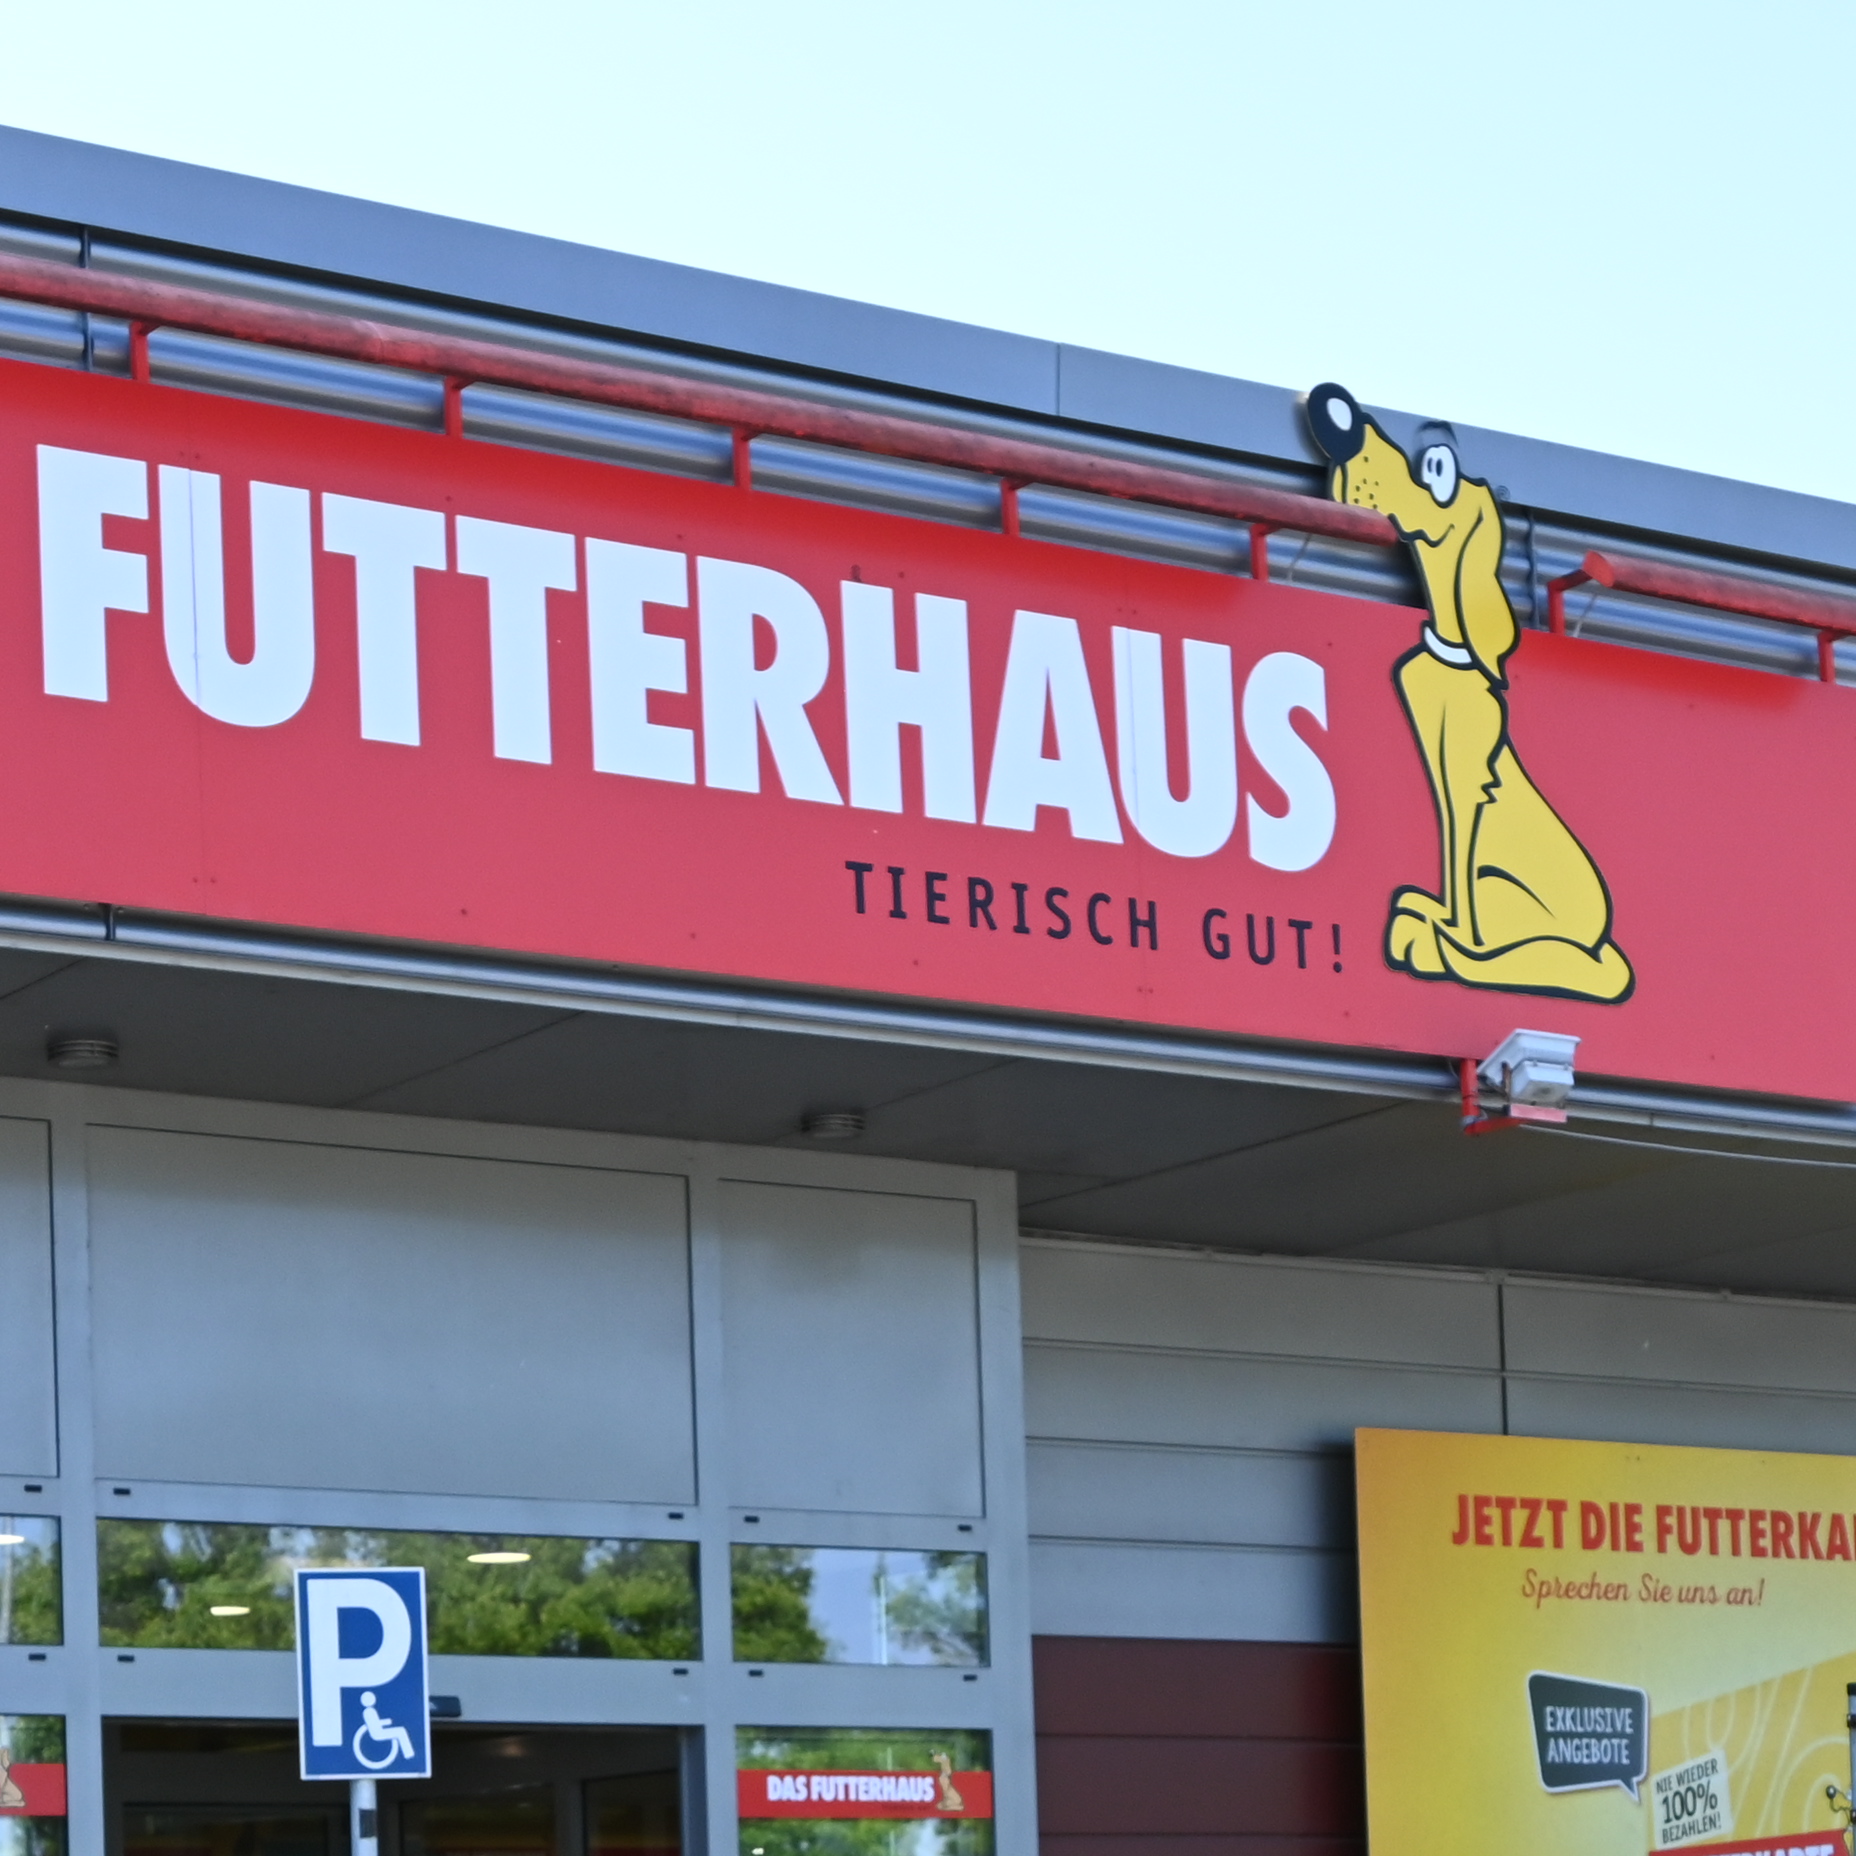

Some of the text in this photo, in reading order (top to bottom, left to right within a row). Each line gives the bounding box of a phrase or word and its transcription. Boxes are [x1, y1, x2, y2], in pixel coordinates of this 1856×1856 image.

[36, 443, 1337, 872] FUTTERHAUS
[845, 860, 1343, 973] TIERISCH GUT!
[1452, 1494, 1568, 1549] JETZT
[1580, 1500, 1645, 1552] DIE
[1521, 1567, 1765, 1609] Sprechen Sie uns an!
[306, 1578, 412, 1747] P
[1546, 1706, 1634, 1734] EXKLUSIVE
[1547, 1738, 1630, 1764] ANGEBOTE
[767, 1775, 935, 1803] DAS FUTTERHAUS
[1656, 1758, 1719, 1795] NIE WIEDER
[1662, 1780, 1718, 1824] 100%
[1662, 1812, 1722, 1844] BEZAHLEN!
